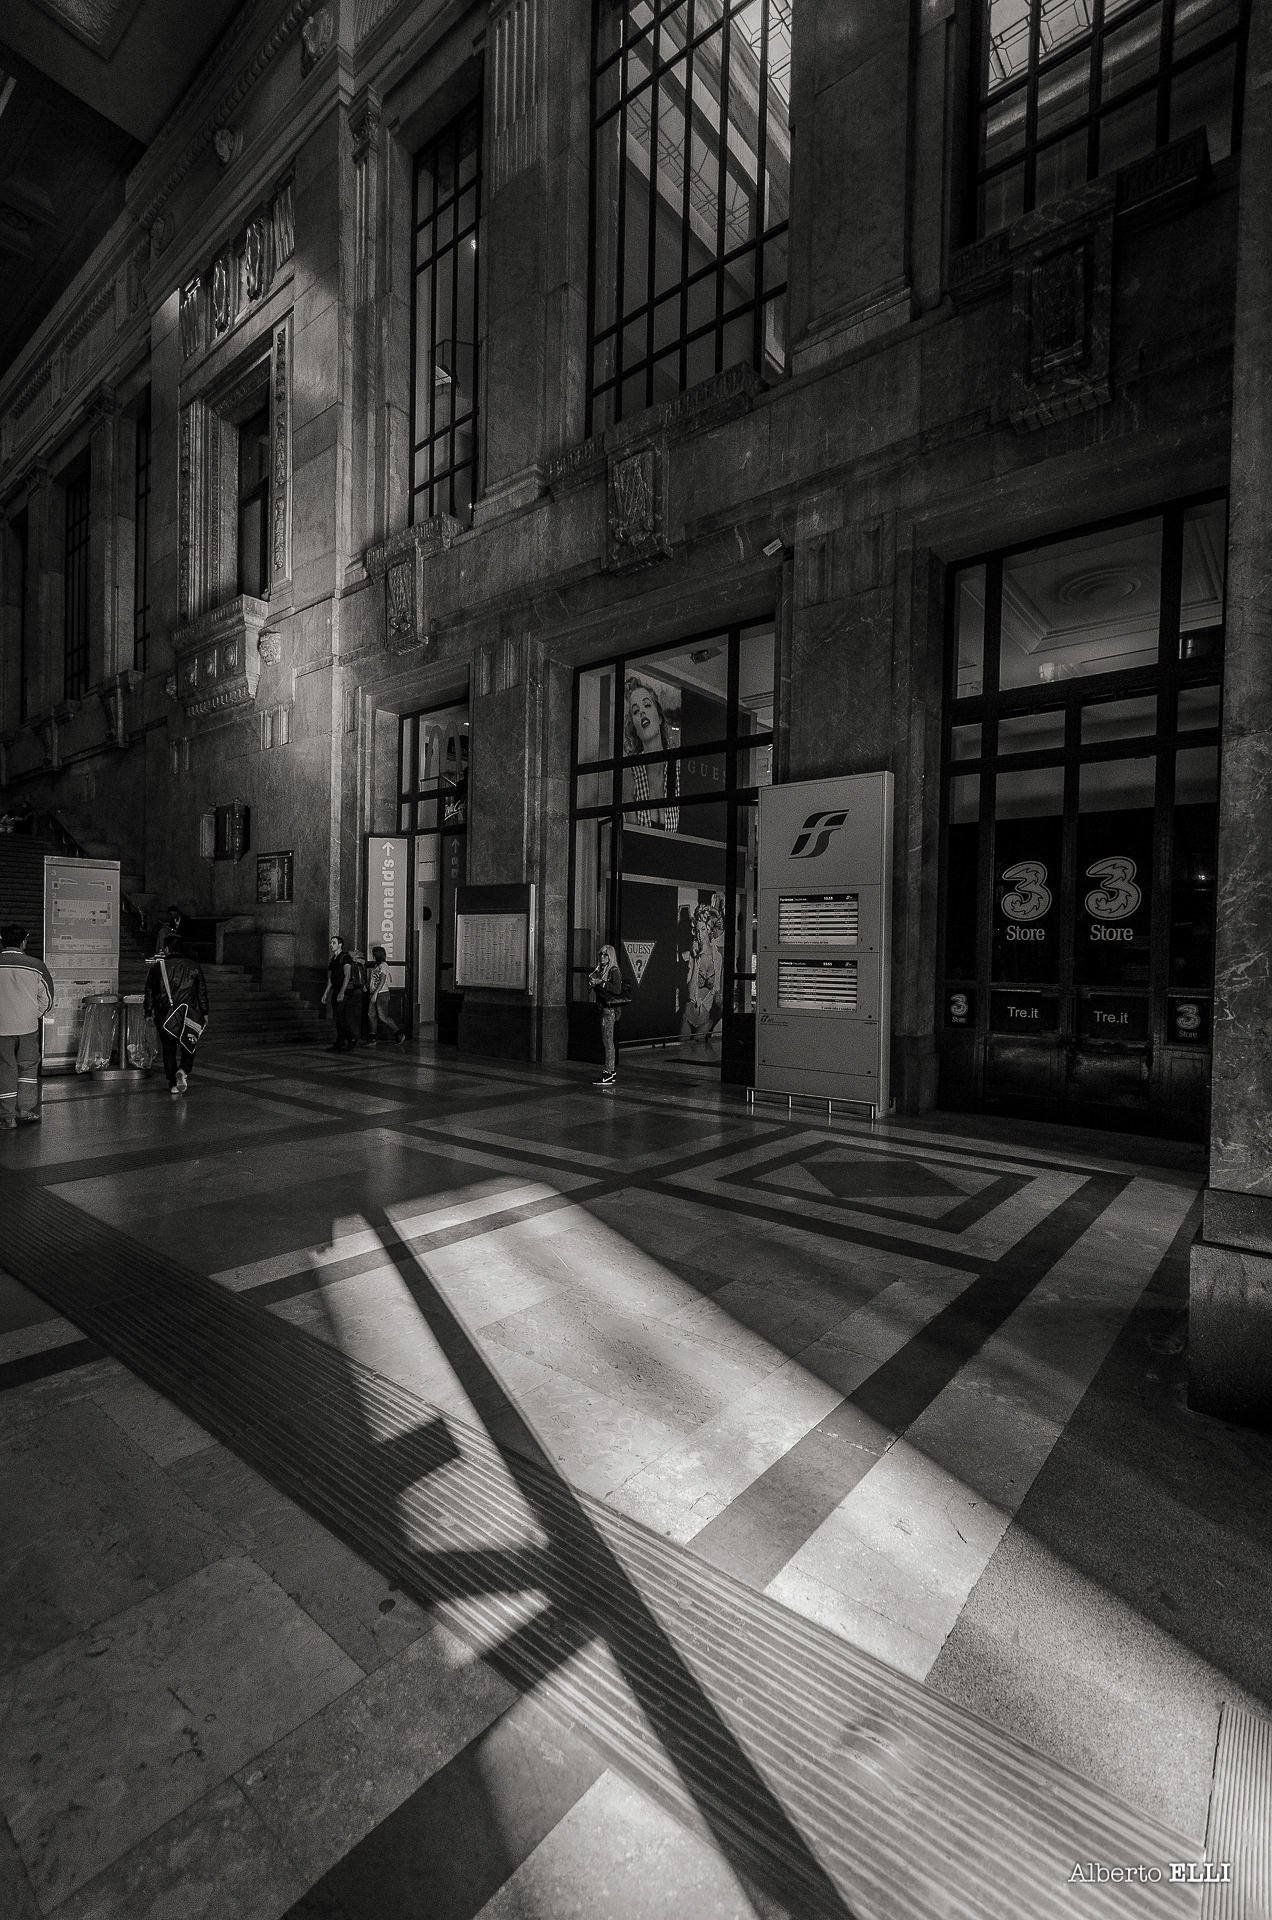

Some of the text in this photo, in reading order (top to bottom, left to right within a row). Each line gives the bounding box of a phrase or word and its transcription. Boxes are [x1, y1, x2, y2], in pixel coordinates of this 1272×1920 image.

[1006, 924, 1046, 941] Store
[1090, 924, 1134, 941] Store
[627, 943, 652, 954] GUESS
[1007, 1006, 1039, 1019] Tre.it
[1093, 1010, 1129, 1024] Tre.it
[1178, 1030, 1198, 1039] Store
